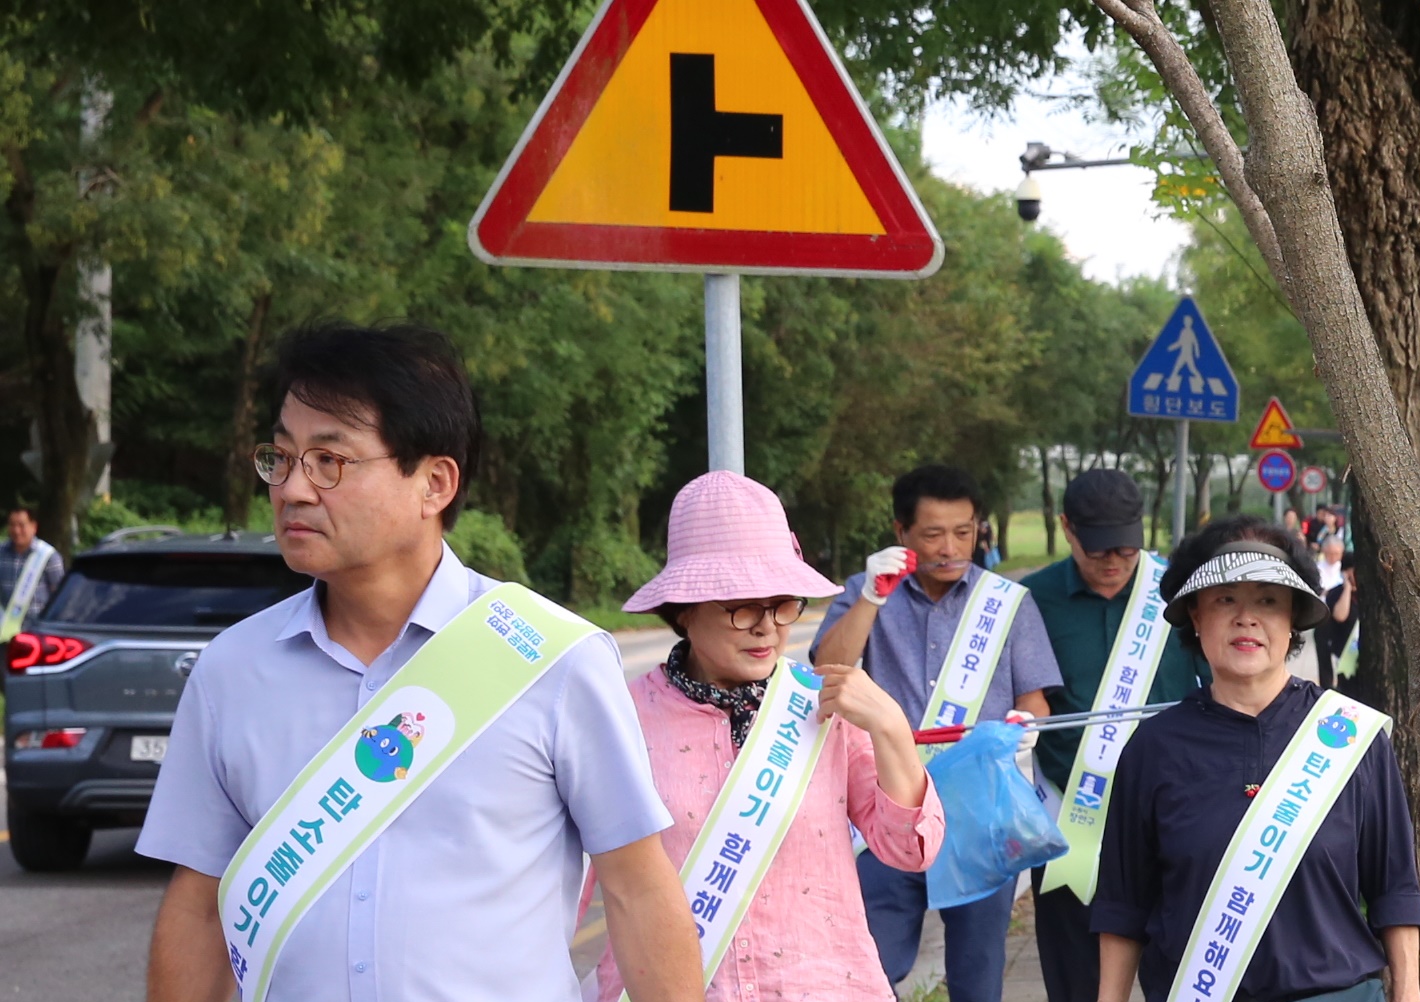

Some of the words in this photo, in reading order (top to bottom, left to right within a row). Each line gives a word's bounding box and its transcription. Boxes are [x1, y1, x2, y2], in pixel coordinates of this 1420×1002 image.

[1143, 394, 1228, 417] 횡단보도
[486, 614, 511, 638] 변화
[490, 599, 515, 621] 장안
[510, 616, 545, 647] 희망찬
[508, 632, 542, 663] 새로운
[961, 597, 1003, 690] 함께해요!
[738, 690, 814, 828] 탄소줄이기
[1243, 750, 1333, 881] 탄소줄이기
[233, 776, 364, 949] 탄소줄이기
[690, 831, 752, 940] 함께해
